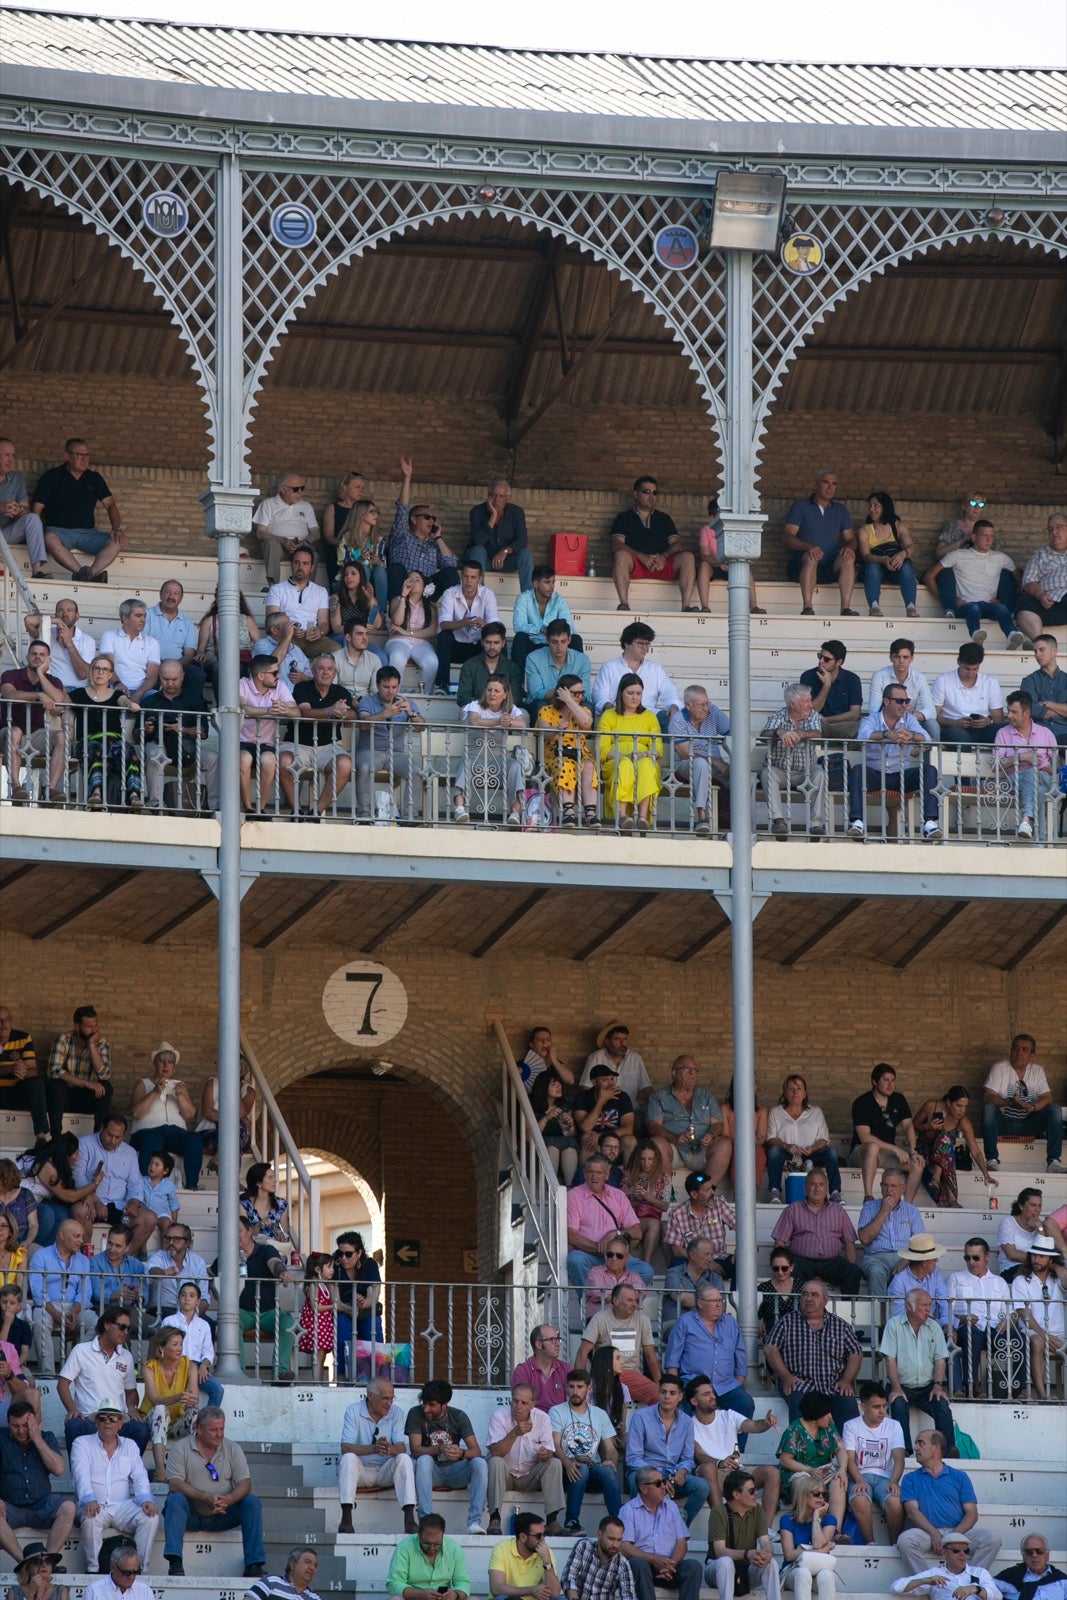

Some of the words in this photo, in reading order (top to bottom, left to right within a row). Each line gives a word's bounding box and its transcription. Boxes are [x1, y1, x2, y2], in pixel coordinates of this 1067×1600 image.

[1020, 656, 1028, 664] 17
[346, 972, 383, 1036] 7
[297, 1393, 314, 1402] 22
[260, 1443, 273, 1452] 17
[864, 1450, 879, 1458] FILA
[286, 1487, 298, 1498] 16
[1009, 1518, 1025, 1528] 40
[305, 1533, 317, 1544] 15
[64, 1540, 80, 1551] 27
[195, 1544, 212, 1554] 29
[329, 1580, 343, 1591] 14
[219, 1591, 235, 1600] 28
